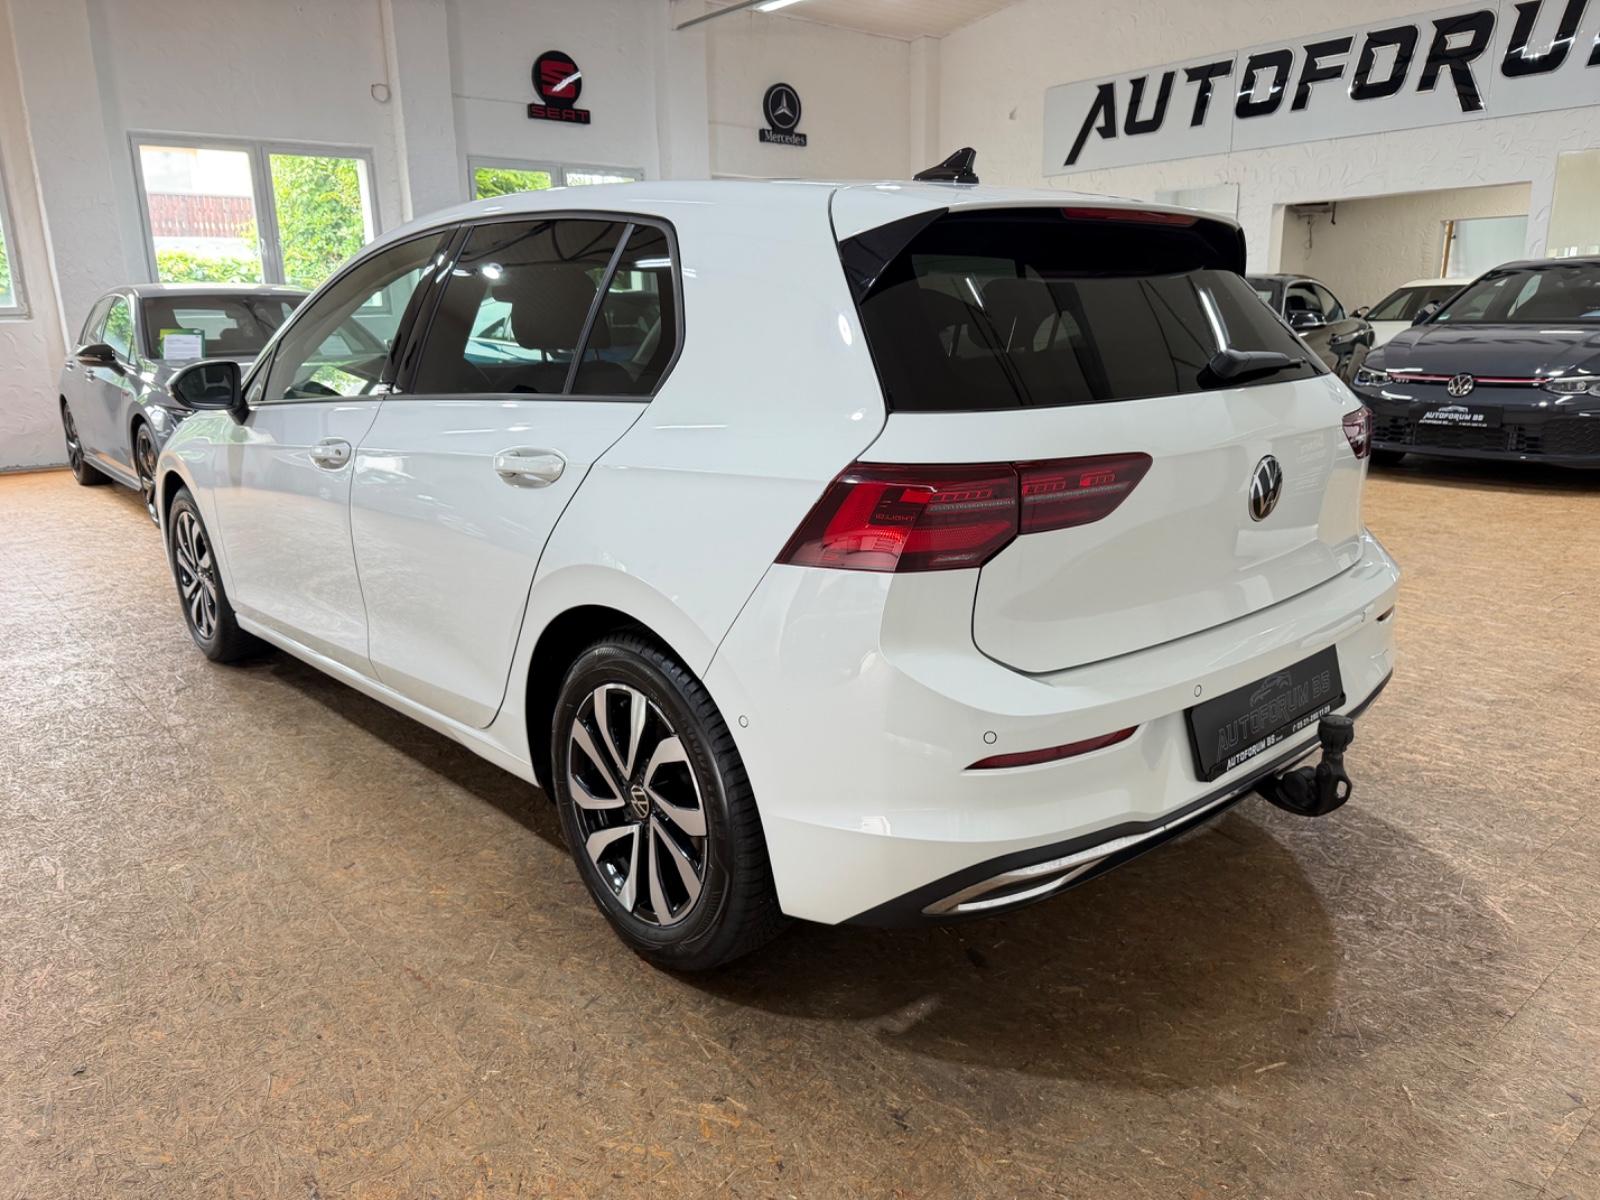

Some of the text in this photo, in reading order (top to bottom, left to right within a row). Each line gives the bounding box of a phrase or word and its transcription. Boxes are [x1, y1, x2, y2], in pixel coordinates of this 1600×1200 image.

[1063, 0, 1600, 167] AUTOFORU
[531, 105, 589, 121] SEAT
[765, 130, 805, 144] Mercedes
[1423, 411, 1471, 421] AUTOFORUM
[1217, 680, 1309, 763] AUTOFORUM
[1226, 738, 1266, 772] AUTOFORUM
